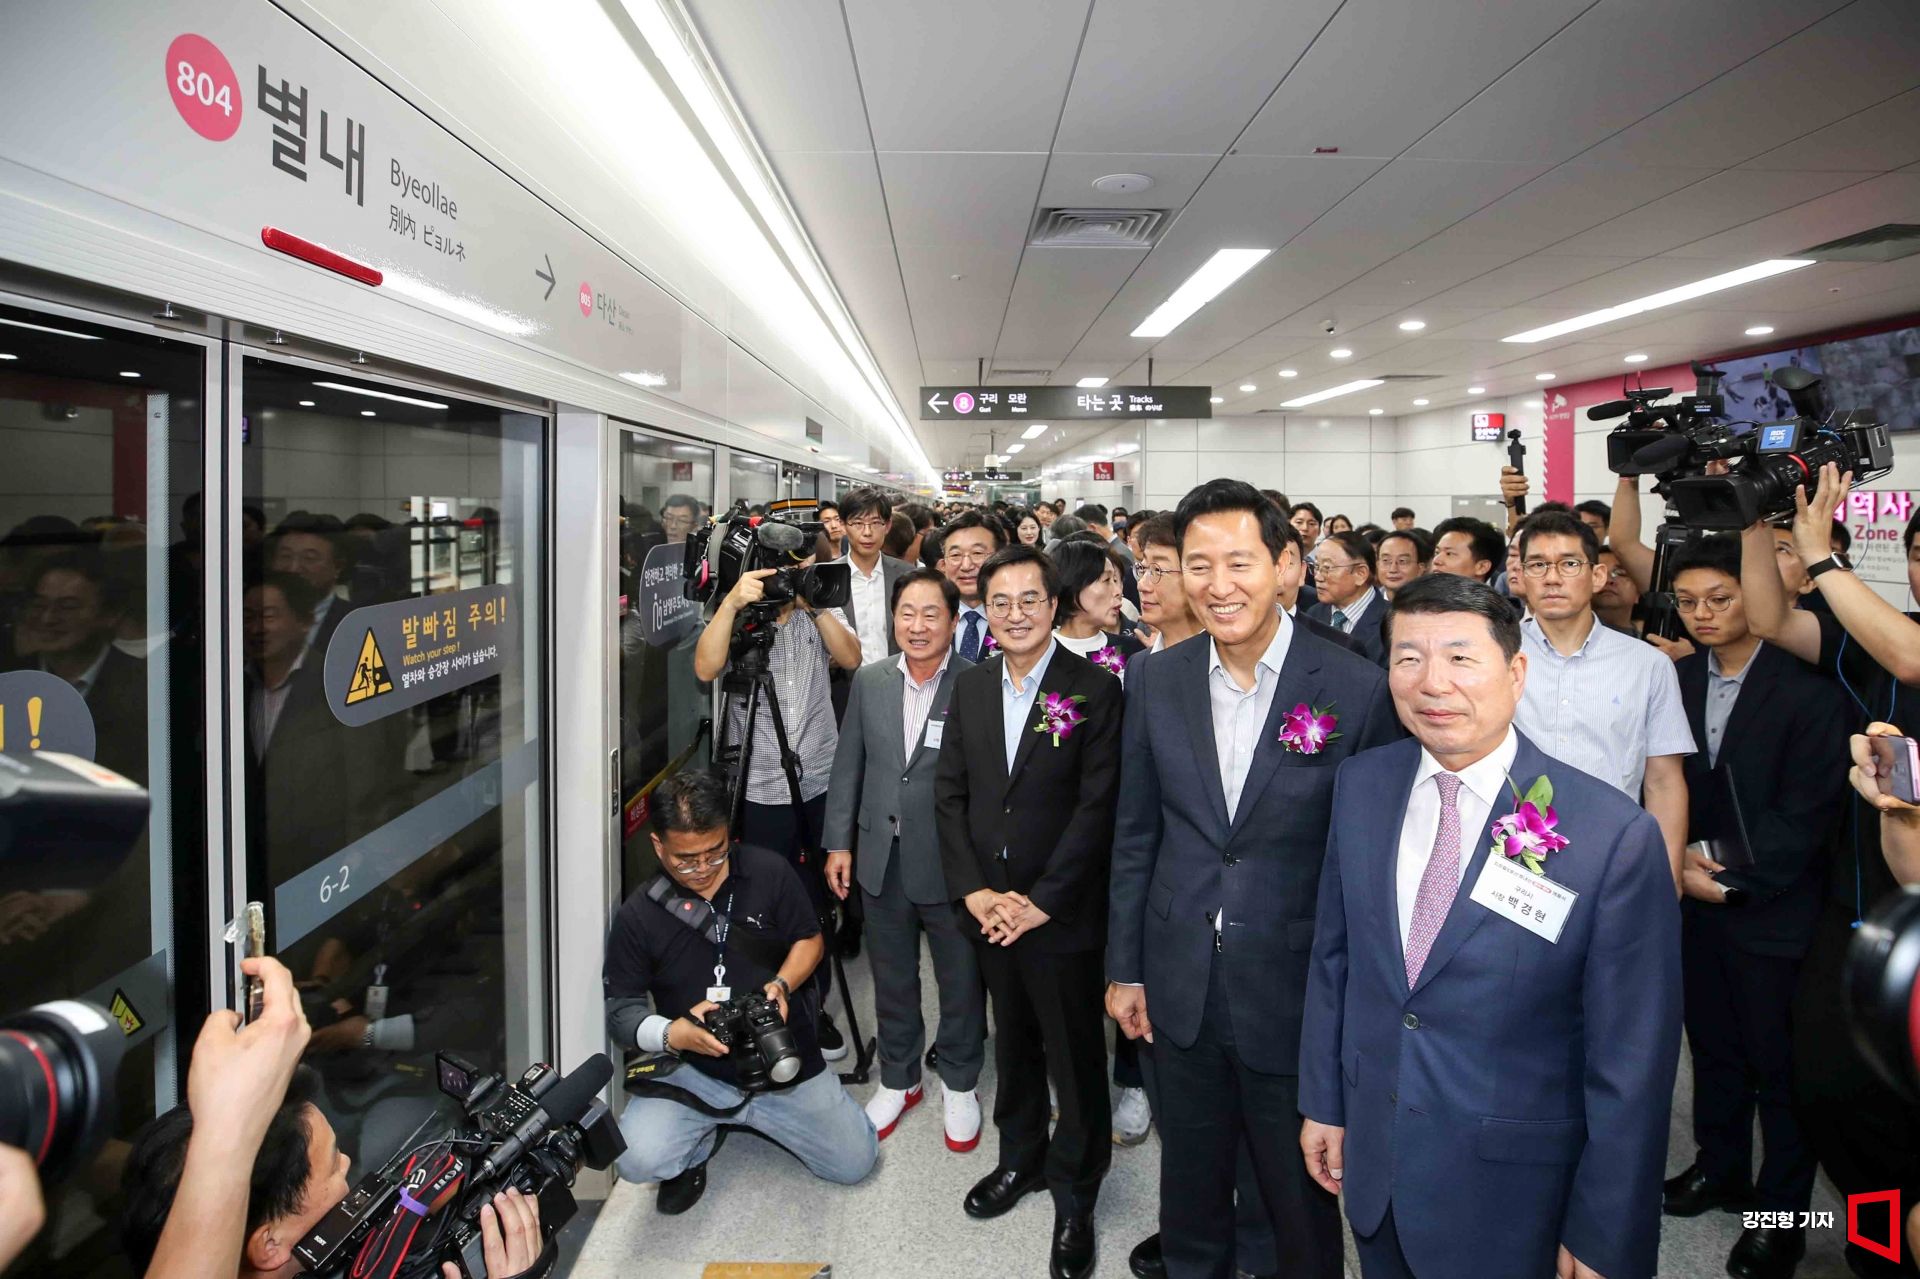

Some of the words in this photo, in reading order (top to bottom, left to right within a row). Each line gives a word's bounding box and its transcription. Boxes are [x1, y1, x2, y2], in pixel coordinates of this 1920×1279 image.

[176, 60, 233, 117] 804
[257, 64, 366, 208] 별내
[390, 158, 458, 221] Byeollae
[422, 224, 467, 263] ピョルネ
[597, 292, 617, 327] 다산
[978, 392, 999, 405] 구리
[1007, 392, 1028, 405] 모란
[1076, 394, 1106, 411] 타는
[1108, 394, 1124, 411] 곳
[1128, 395, 1154, 403] Tracks
[1833, 491, 1914, 523] 역사
[1854, 524, 1898, 541] Zone
[644, 566, 665, 588] 안전하고
[467, 596, 507, 631] 주의!
[401, 667, 426, 689] 열차와
[427, 660, 450, 680] 승강장
[451, 652, 472, 672] 사이가
[472, 644, 499, 665] 넓습니다.
[402, 651, 426, 667] Watch
[426, 648, 441, 662] your
[320, 865, 350, 904] 6-2
[1515, 885, 1534, 900] 구리시
